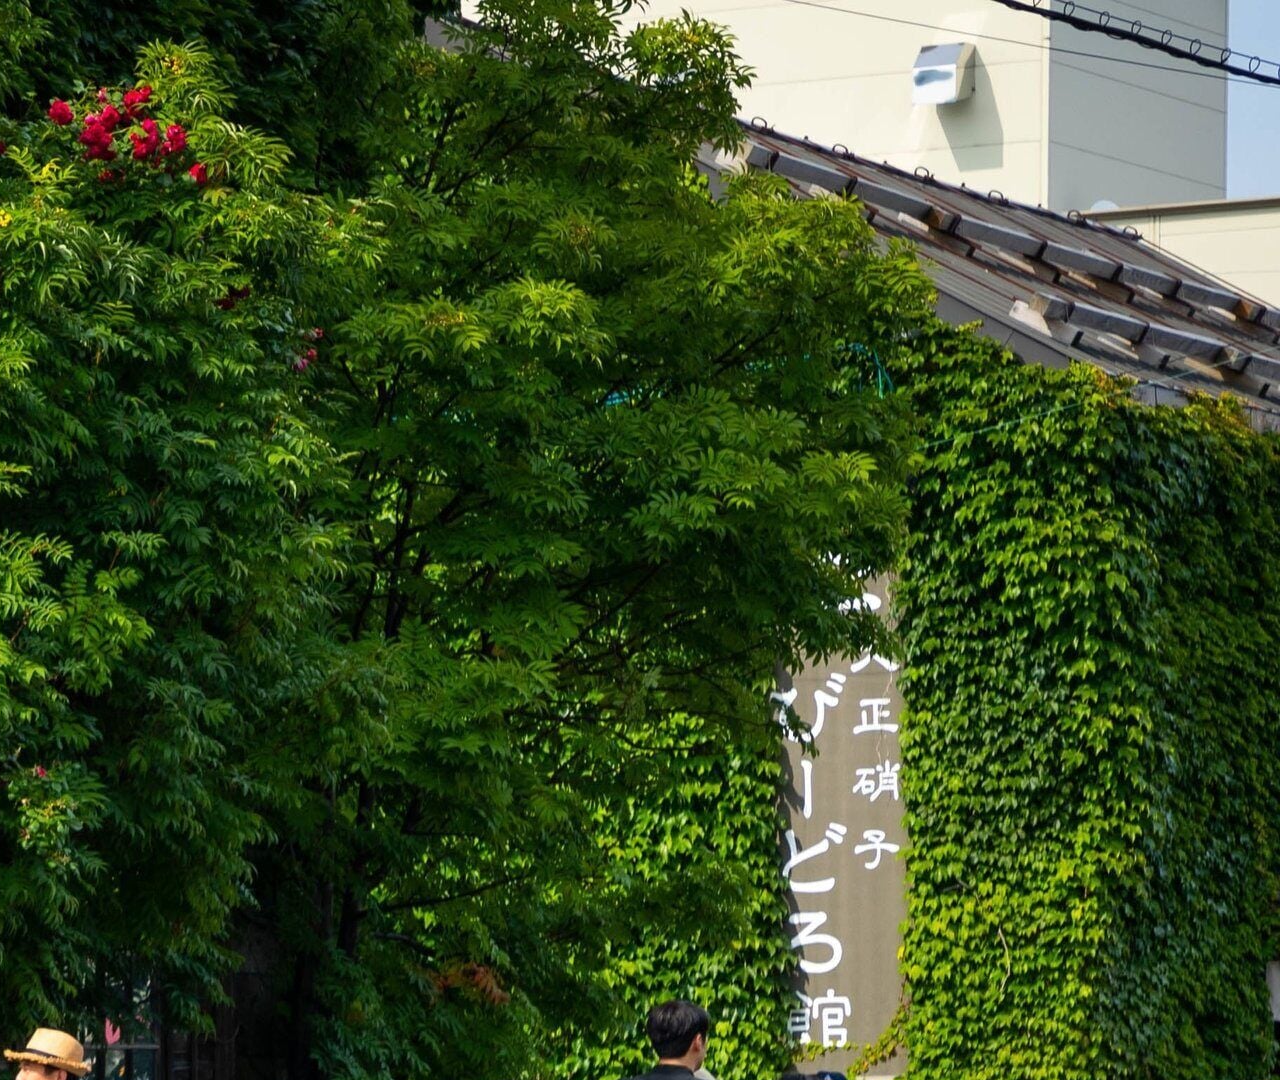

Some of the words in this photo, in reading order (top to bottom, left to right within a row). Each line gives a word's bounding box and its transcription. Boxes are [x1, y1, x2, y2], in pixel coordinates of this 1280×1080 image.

[770, 672, 852, 1048] びーどろ館
